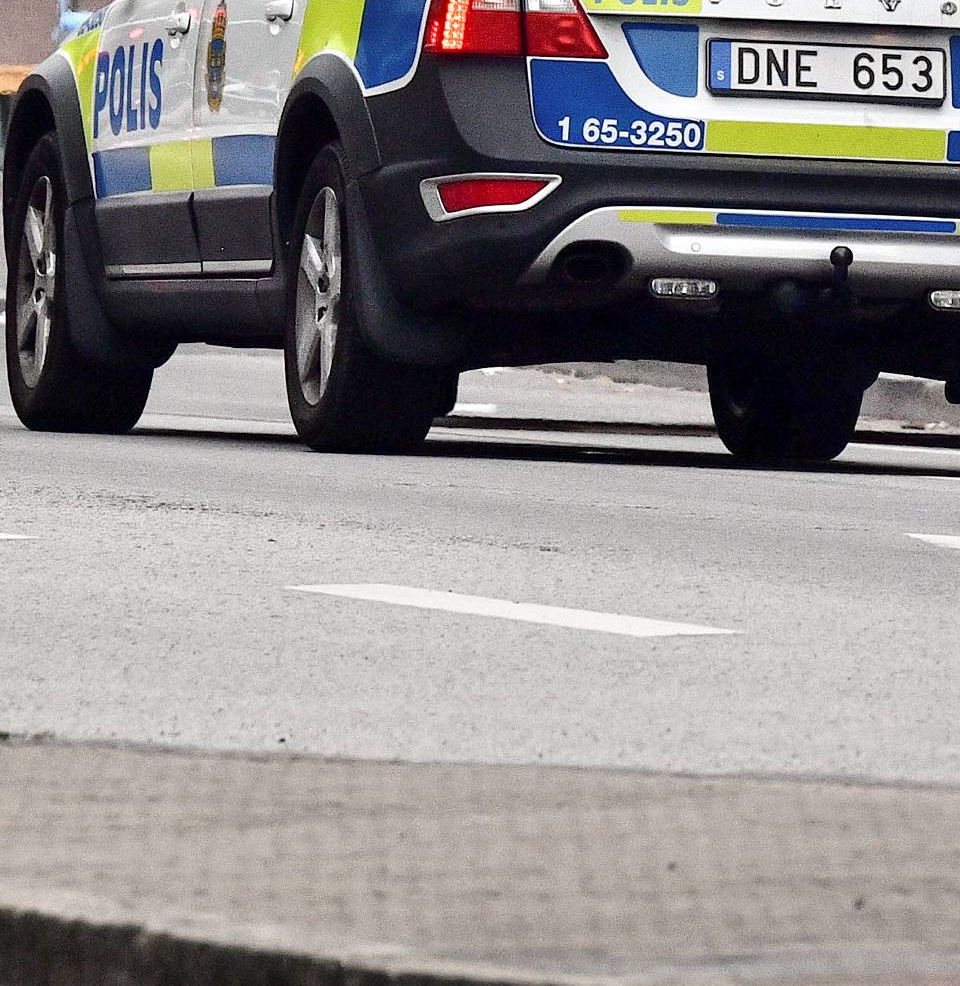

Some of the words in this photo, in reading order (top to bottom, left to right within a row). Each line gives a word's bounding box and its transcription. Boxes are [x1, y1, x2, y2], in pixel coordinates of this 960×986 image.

[93, 38, 164, 139] POLIS
[737, 47, 818, 88] DNE
[852, 52, 933, 93] 653
[558, 116, 570, 141] 1
[582, 117, 701, 148] 65-3250
